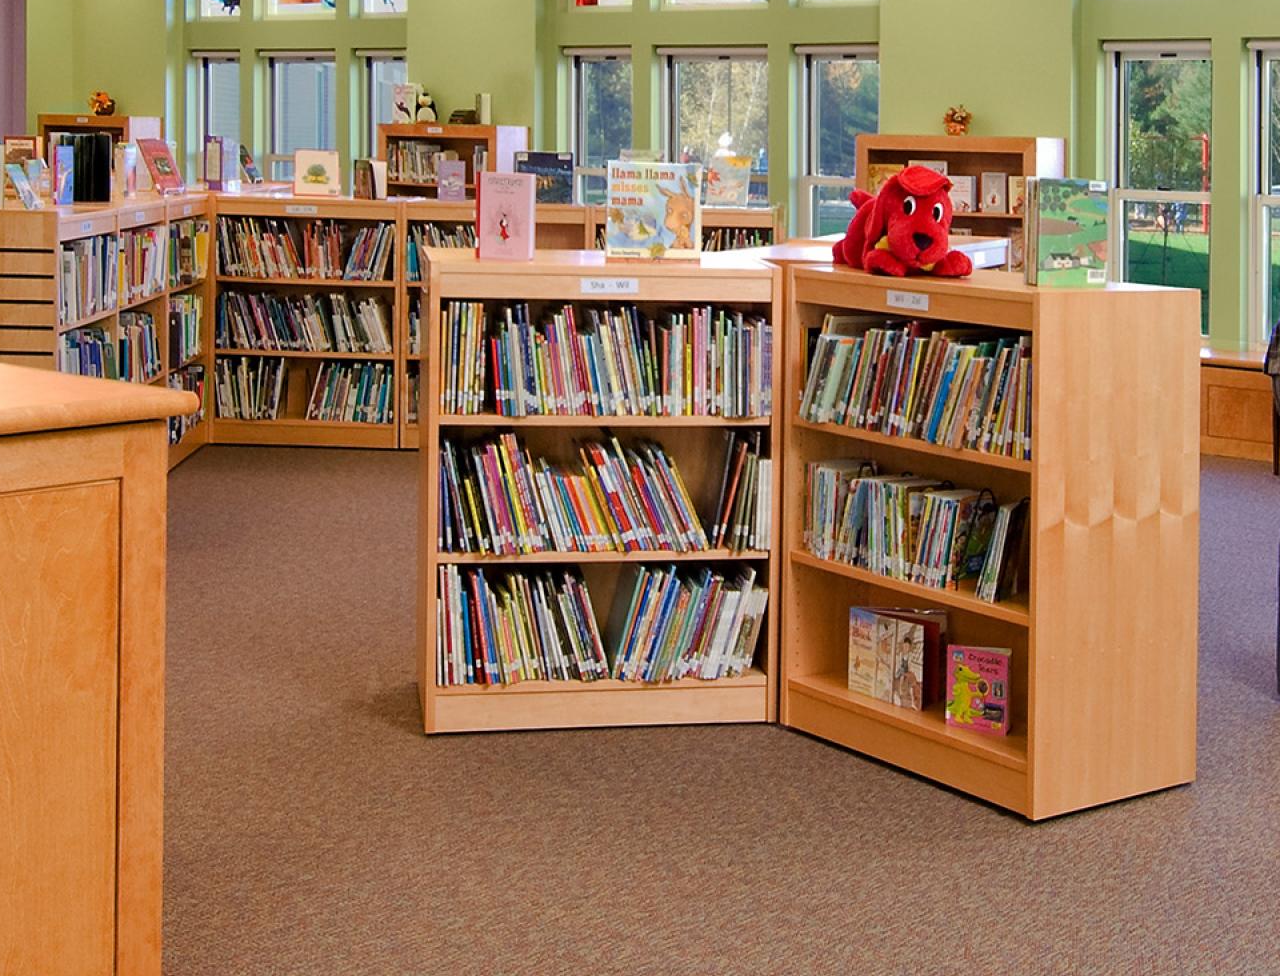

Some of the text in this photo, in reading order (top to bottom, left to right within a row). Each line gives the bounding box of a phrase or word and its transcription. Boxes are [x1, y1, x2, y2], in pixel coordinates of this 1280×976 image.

[612, 167, 675, 181] llama llama
[611, 196, 644, 207] mama
